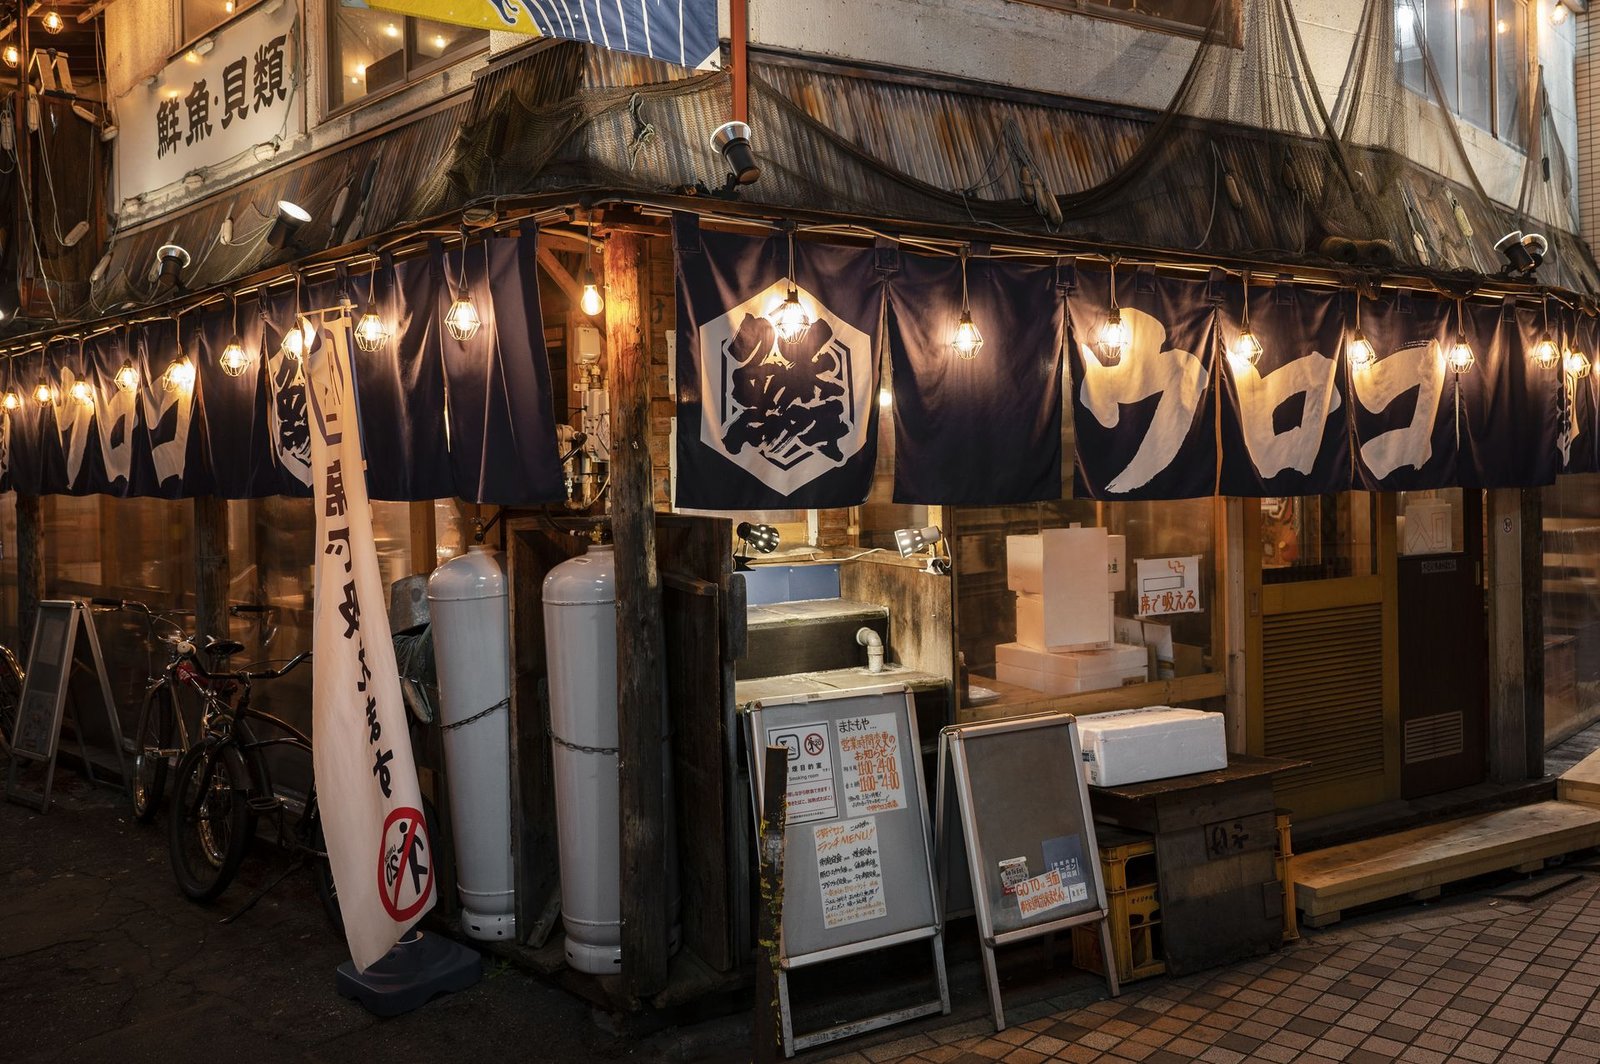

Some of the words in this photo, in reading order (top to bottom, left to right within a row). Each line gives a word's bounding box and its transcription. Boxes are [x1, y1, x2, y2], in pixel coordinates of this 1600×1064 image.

[157, 35, 287, 160] 鮮魚・貝類
[1080, 306, 1447, 494] ウロコ
[1408, 511, 1447, 552] 入口
[1140, 590, 1197, 615] 席で吸える
